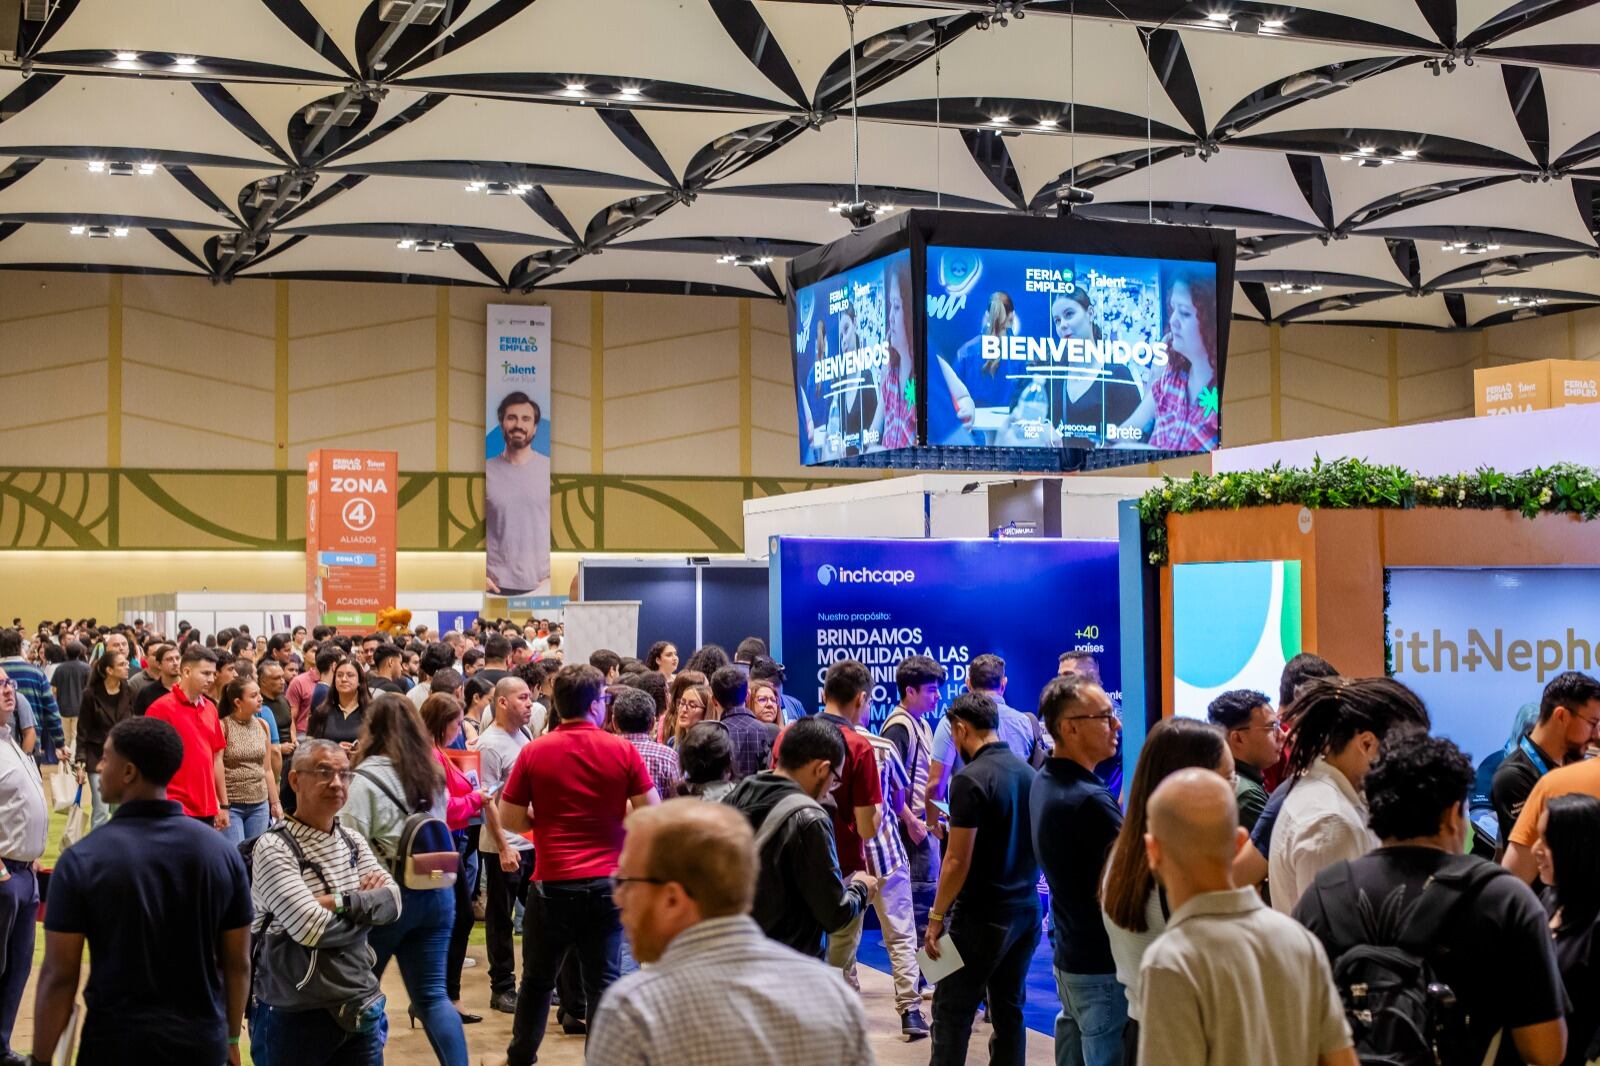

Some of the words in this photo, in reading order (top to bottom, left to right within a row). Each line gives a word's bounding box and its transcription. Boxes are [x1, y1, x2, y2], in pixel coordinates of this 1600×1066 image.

[1026, 268, 1062, 282] FERIA
[1087, 268, 1127, 288] Talent
[1025, 281, 1075, 294] EMPLEO
[829, 288, 845, 304] FERIA
[829, 298, 849, 315] EMPLEO
[499, 336, 528, 345] FERIA
[499, 344, 538, 353] EMPLEO
[981, 334, 1169, 367] BIENVENIDOS
[500, 360, 536, 375] Talent
[814, 341, 890, 384] BIENVENIDOS
[1486, 384, 1505, 394] FERIA
[1564, 379, 1589, 389] FERIA
[1486, 392, 1514, 403] EMPLEO
[1564, 388, 1598, 398] EMPLEO
[863, 429, 880, 445] Brete
[1106, 423, 1142, 440] Brete
[330, 477, 388, 494] ZONA
[348, 503, 367, 525] 4
[340, 535, 377, 544] ALIADOS
[839, 566, 915, 586] inchcape
[336, 598, 380, 606] ACADEMIA
[818, 612, 850, 621] Nuestro
[851, 611, 892, 622] propósito:
[817, 627, 923, 646] BRINDAMOS
[1074, 625, 1099, 640] +40
[1074, 642, 1105, 653] países
[817, 647, 917, 665] MOVILIDAD
[923, 647, 935, 661] A
[939, 646, 969, 663] LAS
